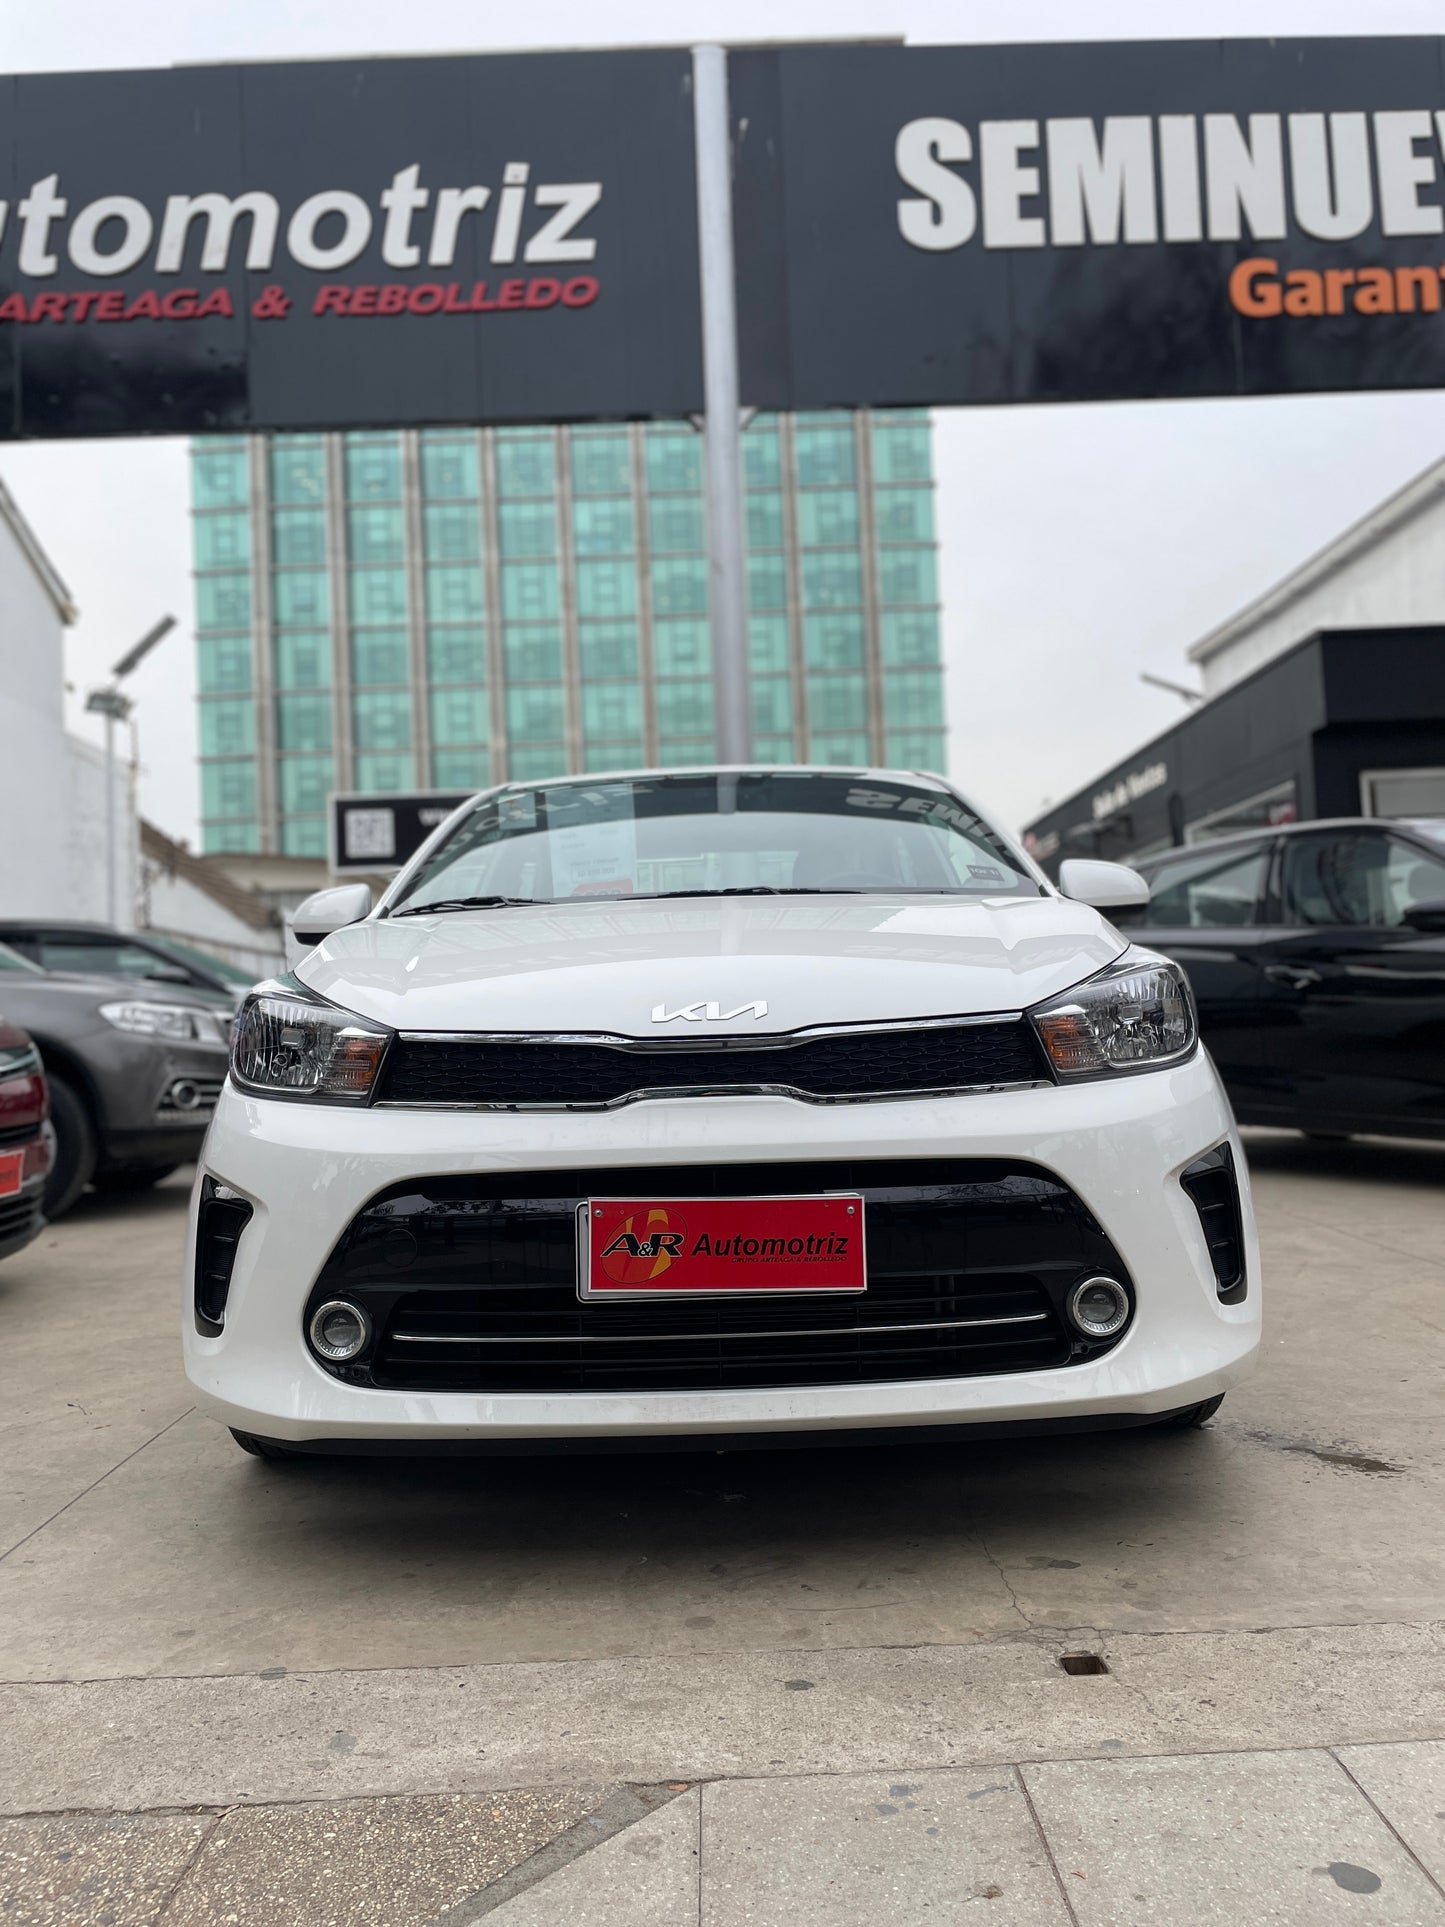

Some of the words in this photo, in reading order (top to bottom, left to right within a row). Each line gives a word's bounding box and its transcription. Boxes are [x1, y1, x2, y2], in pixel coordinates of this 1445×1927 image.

[0, 162, 602, 277] tomotriz
[0, 287, 234, 323] ARTEAGA
[252, 284, 291, 320] &
[312, 276, 600, 316] REBOLLEDO
[1229, 257, 1445, 318] Garan
[600, 1232, 684, 1258] A&R
[690, 1232, 849, 1257] Automotriz
